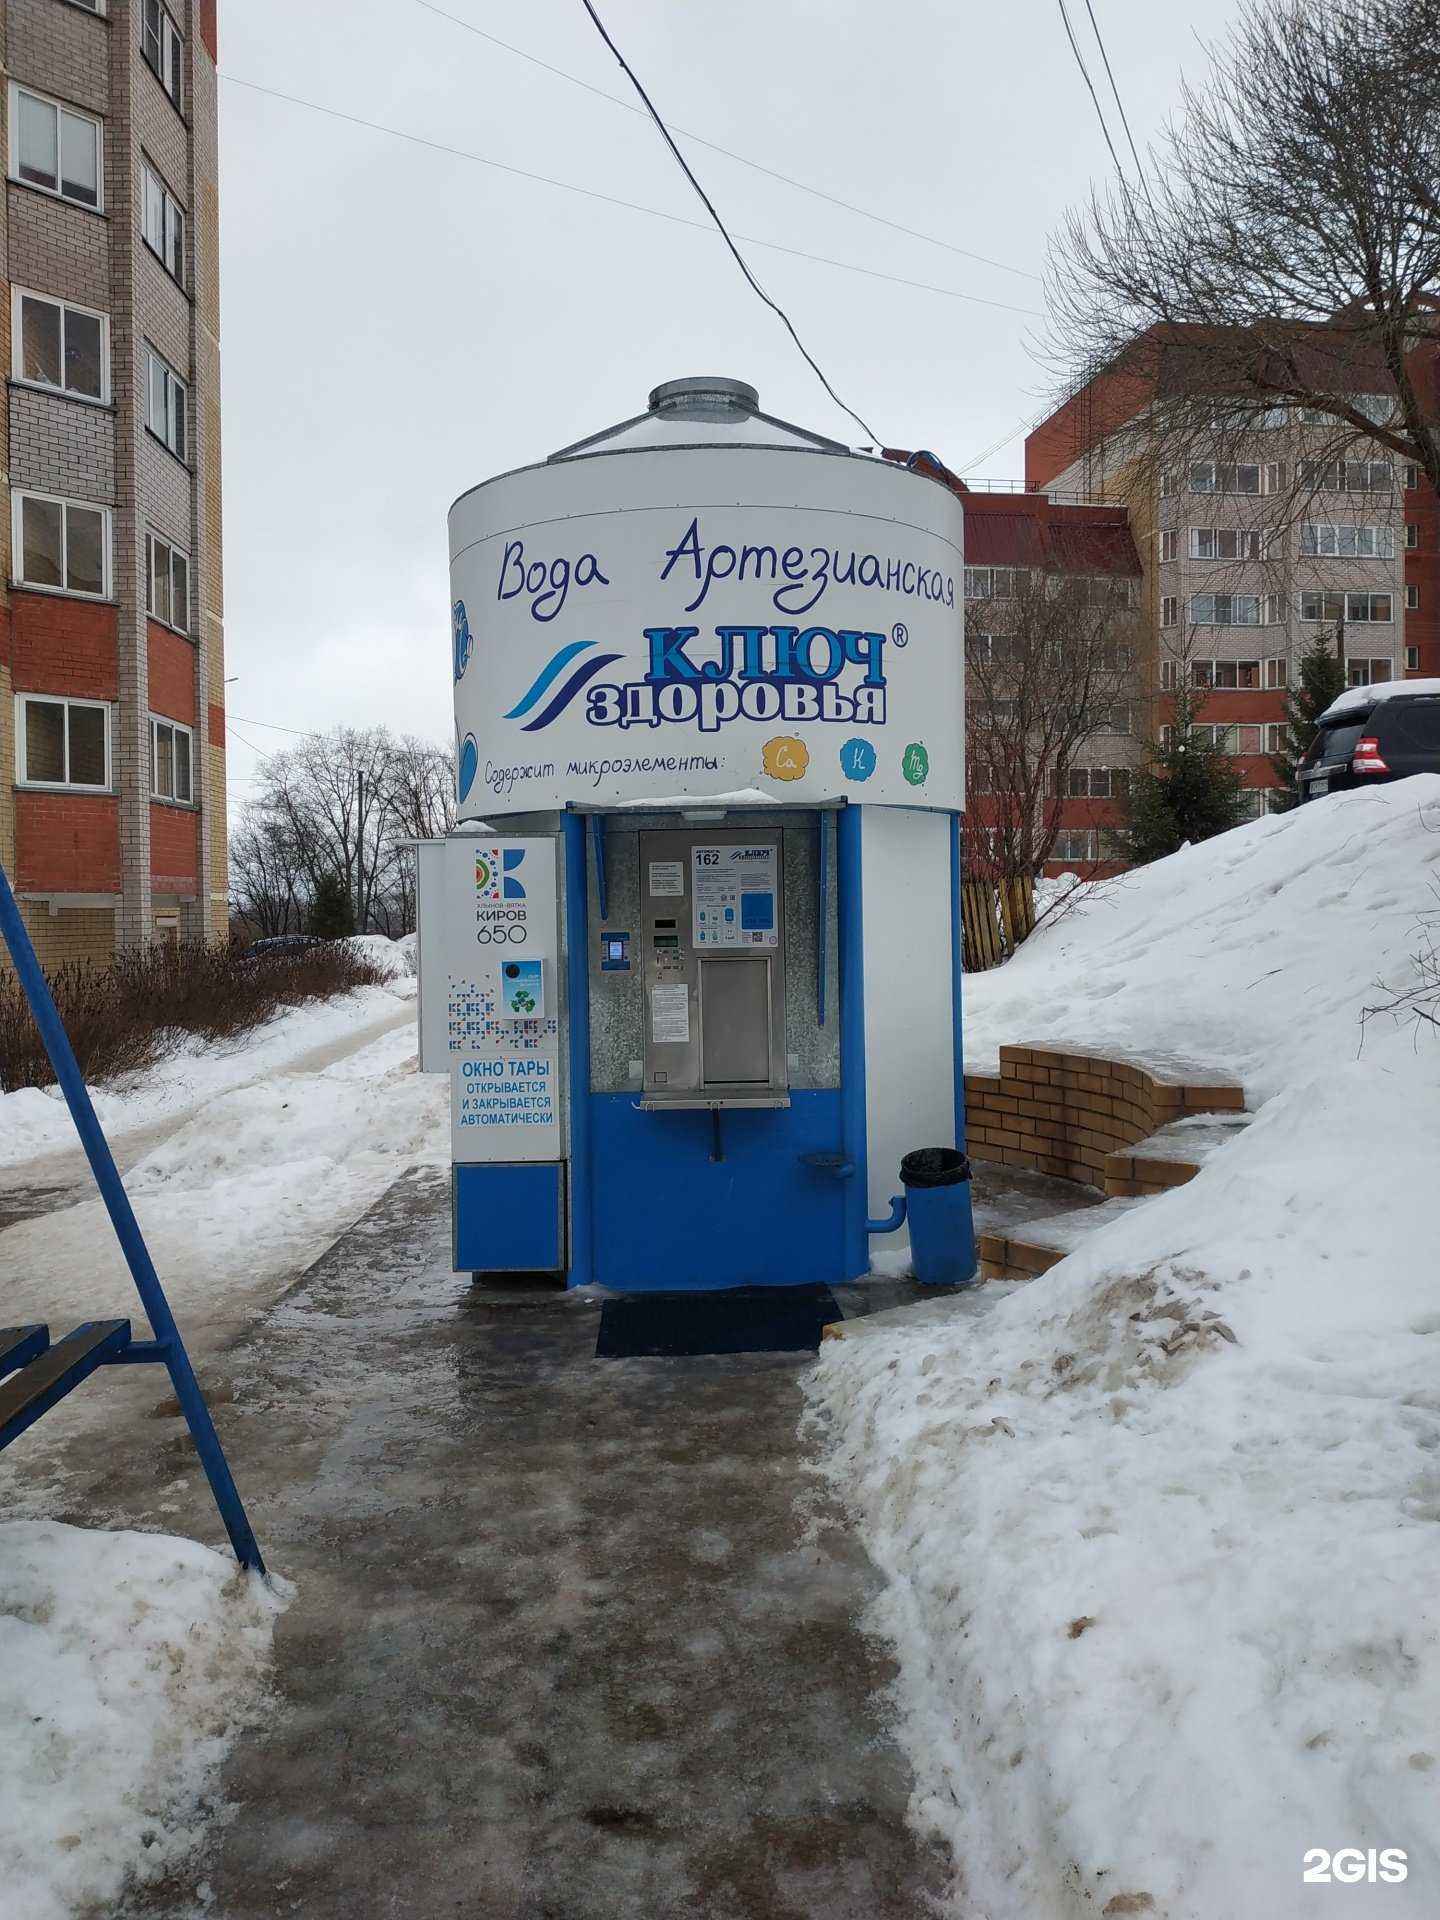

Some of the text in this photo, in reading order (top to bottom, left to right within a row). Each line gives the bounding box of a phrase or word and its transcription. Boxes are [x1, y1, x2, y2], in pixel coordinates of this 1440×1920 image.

[498, 516, 955, 622] Вода Артезианская
[643, 626, 887, 686] КЛЮЧ
[586, 679, 887, 732] здоровья
[776, 745, 798, 769] Ca
[485, 756, 725, 794] Содержит микроэлементы:
[695, 853, 720, 866] 162
[476, 910, 527, 922] КИРОВ
[477, 924, 527, 945] 650
[462, 1060, 550, 1077] ОКНО ТАРЫ
[466, 1081, 546, 1095] ОТКРЫВАЕТСЯ
[462, 1097, 551, 1109] И ЗАКРЫВАЕТСЯ
[460, 1112, 553, 1126] АВТОМАТИЧЕСКИ
